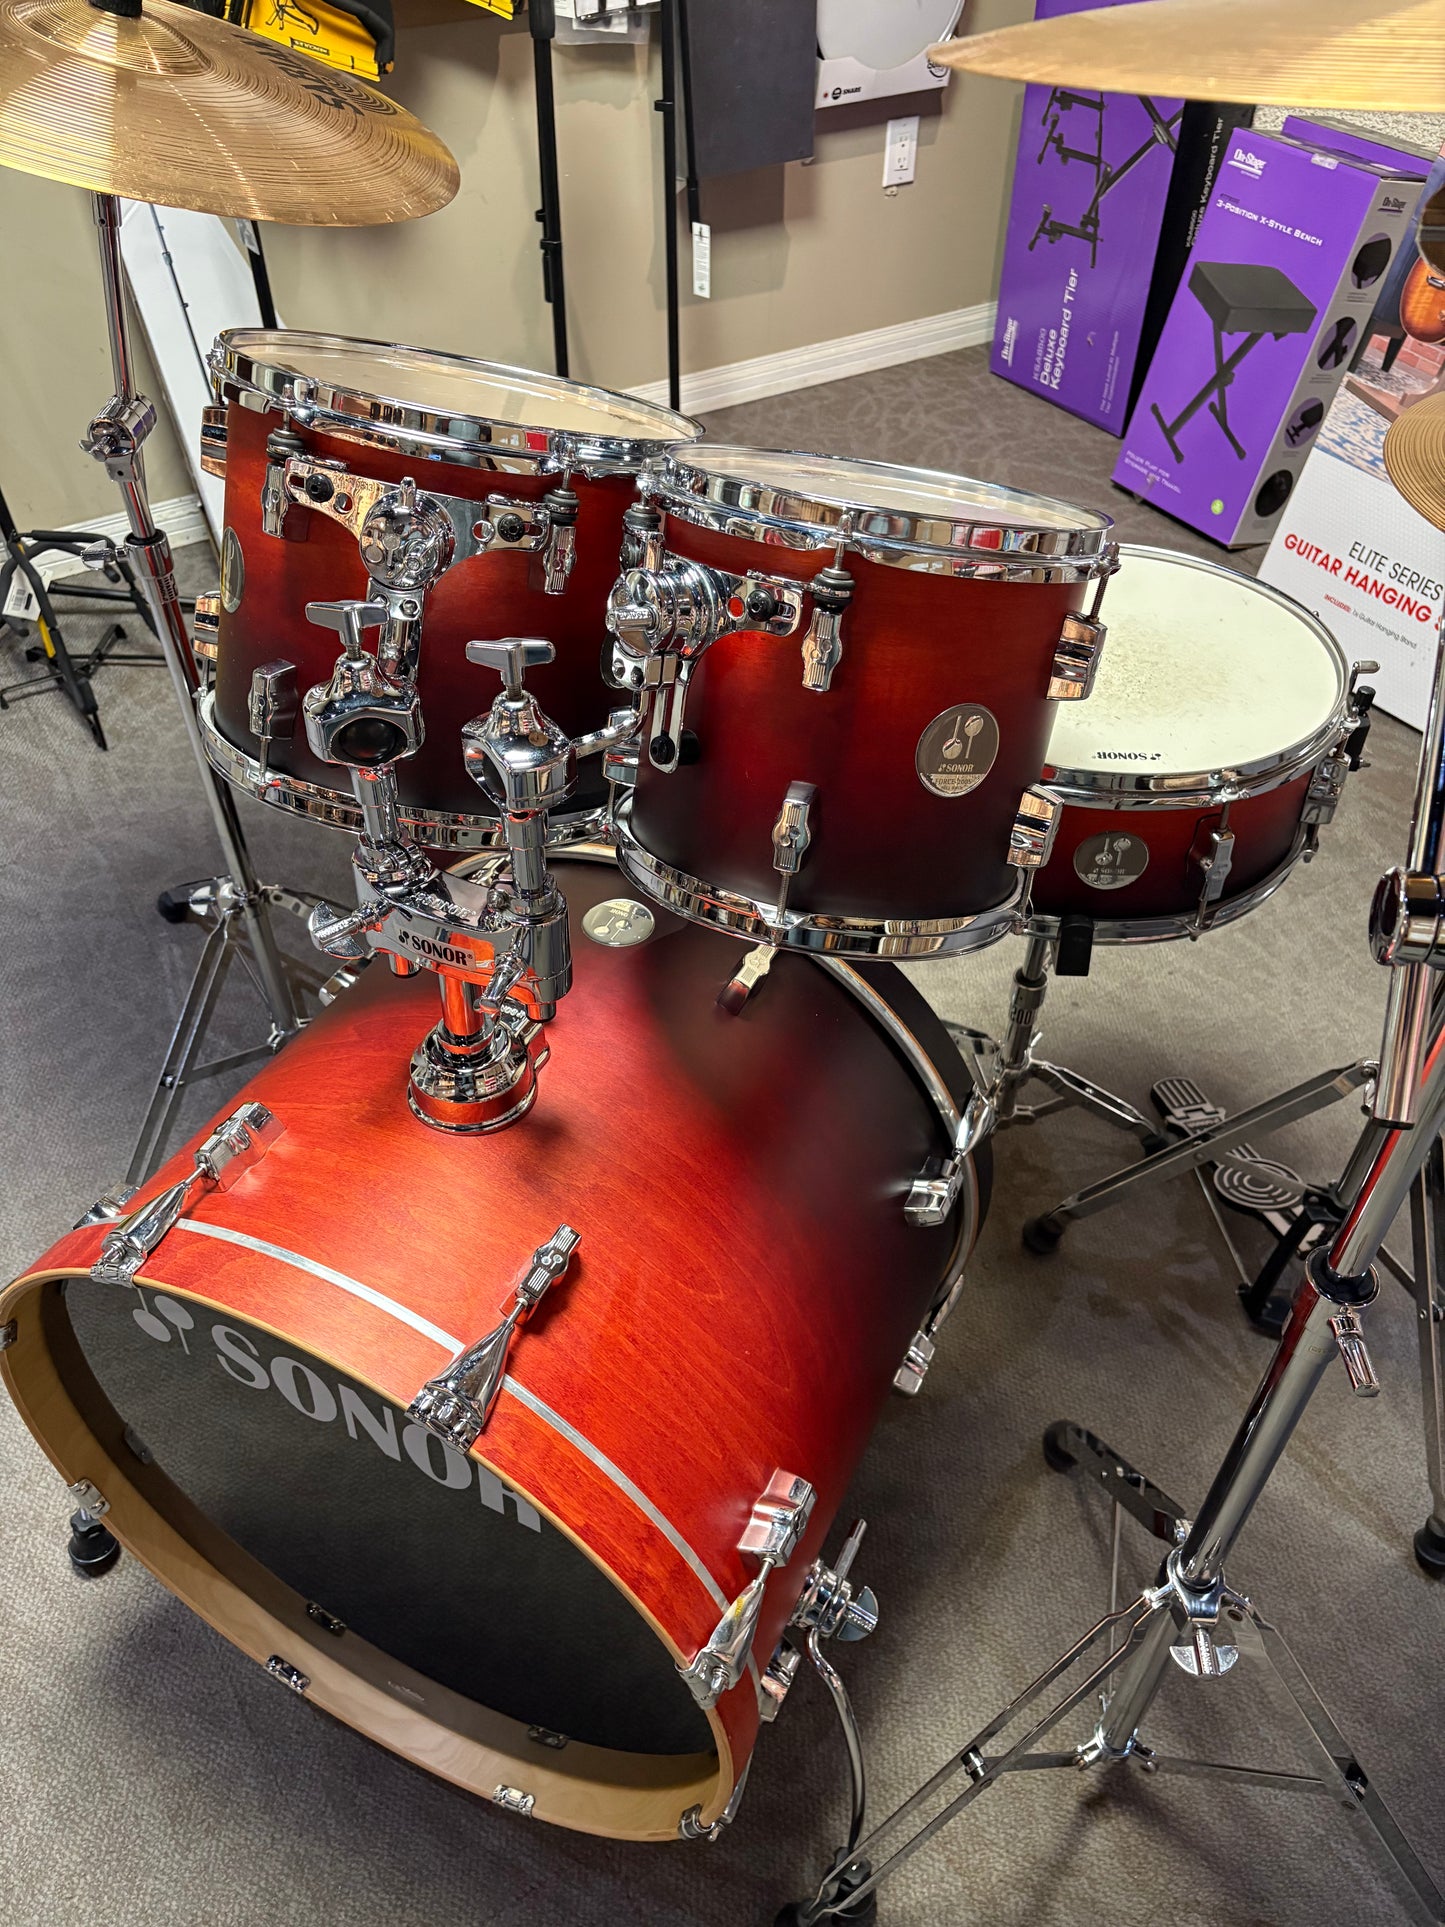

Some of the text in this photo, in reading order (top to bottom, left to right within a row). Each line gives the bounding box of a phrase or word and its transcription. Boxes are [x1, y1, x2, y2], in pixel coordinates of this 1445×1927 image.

[231, 33, 365, 117] SABIAN
[1200, 145, 1218, 203] Keyboard
[1212, 117, 1224, 143] Tier
[1040, 329, 1058, 385] Deluxe
[1049, 268, 1078, 390] Keyboard Tier
[1284, 533, 1432, 623] GUITAR HANGING
[1349, 541, 1443, 601] ELITE SERIES
[946, 763, 974, 773] SONOR
[1097, 752, 1148, 761] SONOR
[411, 935, 467, 966] SONOR
